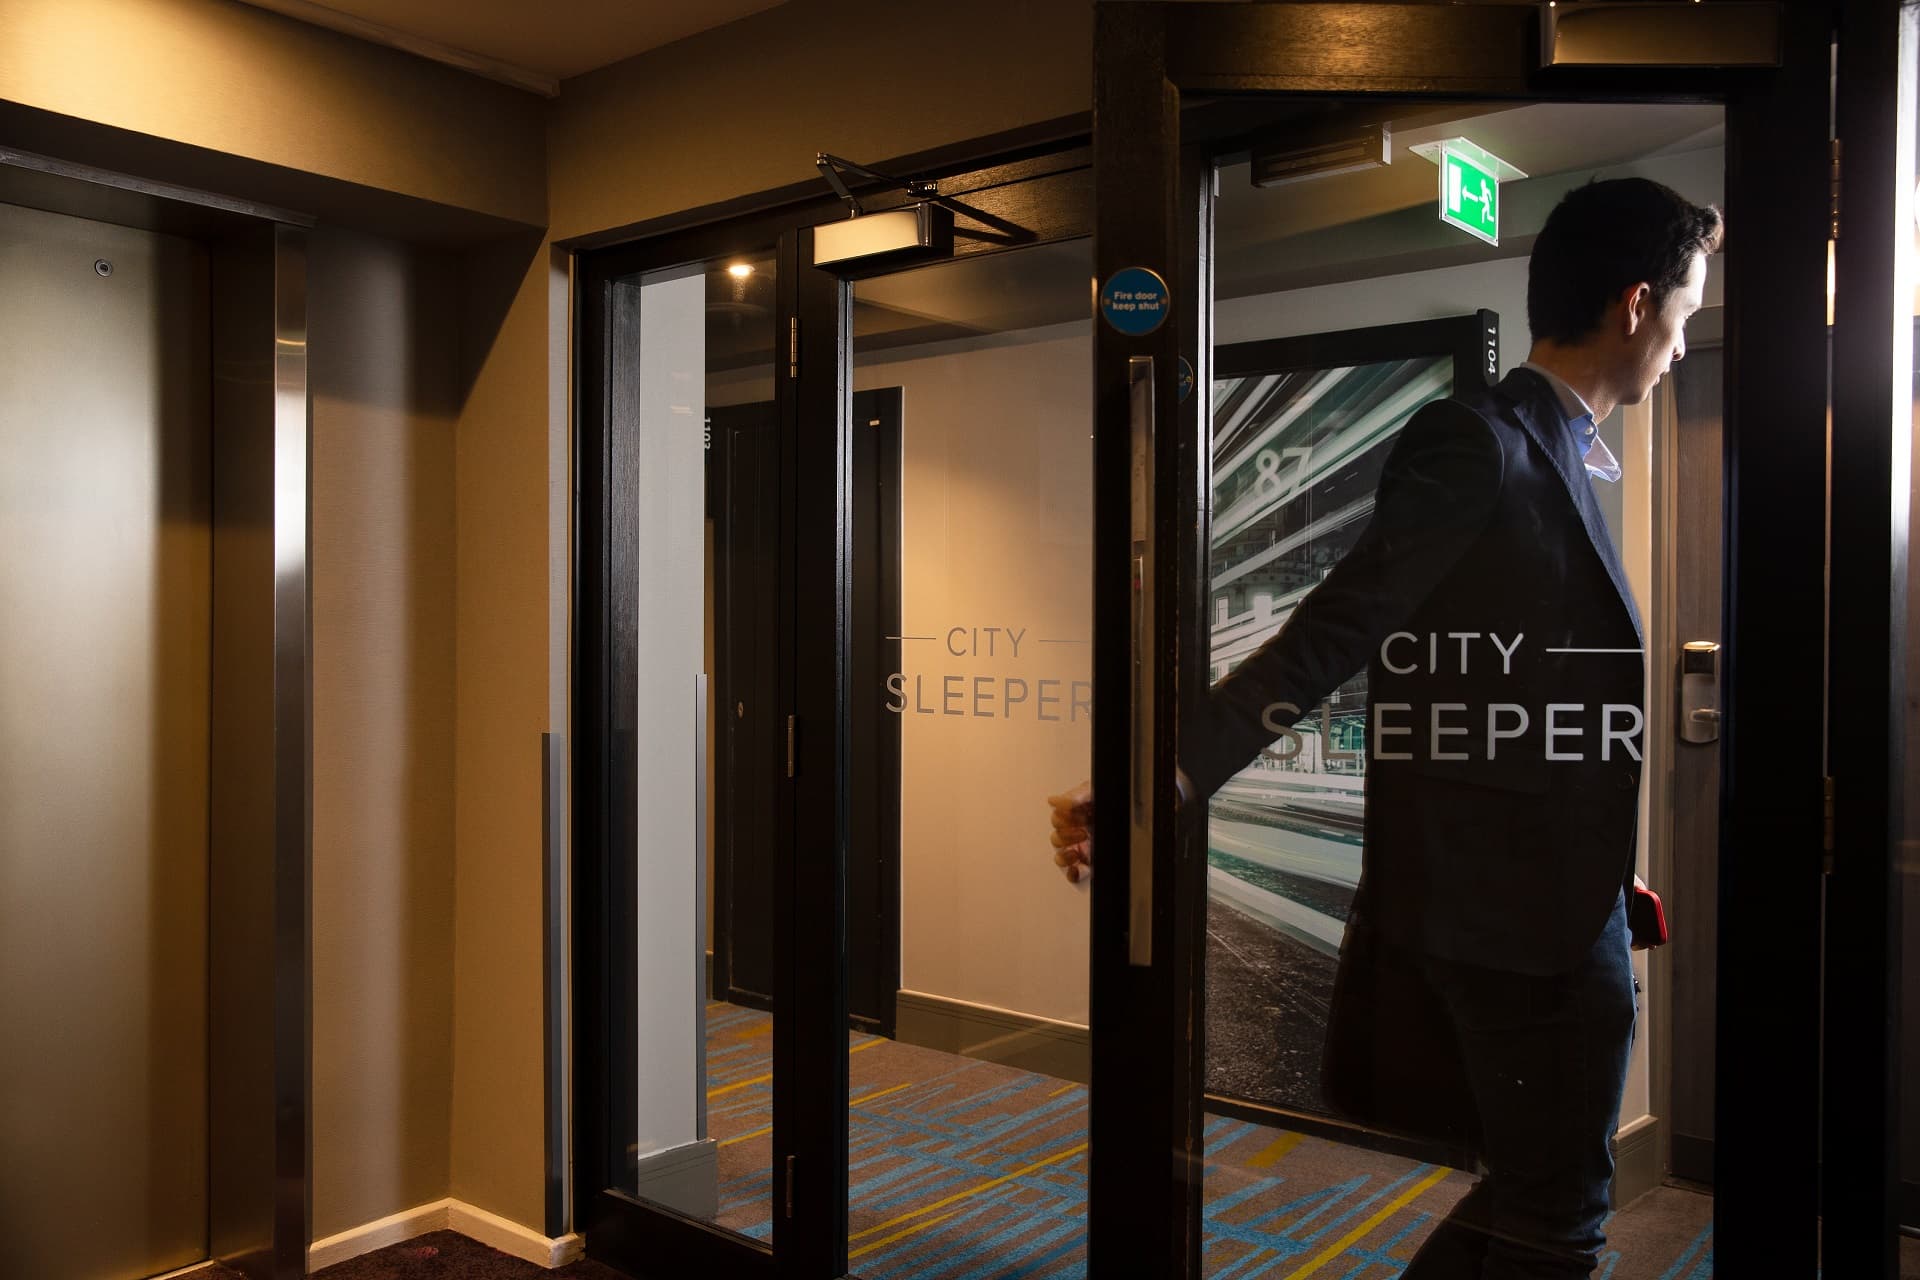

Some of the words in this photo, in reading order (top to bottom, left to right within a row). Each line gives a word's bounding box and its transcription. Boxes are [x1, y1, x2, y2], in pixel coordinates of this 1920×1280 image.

[1112, 301, 1136, 312] keep
[1138, 301, 1160, 310] shut
[1114, 291, 1133, 300] Fire
[1135, 291, 1157, 300] door
[1487, 327, 1497, 374] 1104
[1255, 446, 1313, 497] 87
[947, 627, 1026, 657] CITY
[1380, 632, 1524, 674] CITY
[886, 673, 1092, 722] SLEEPER
[1261, 702, 1644, 761] SLEEPER
